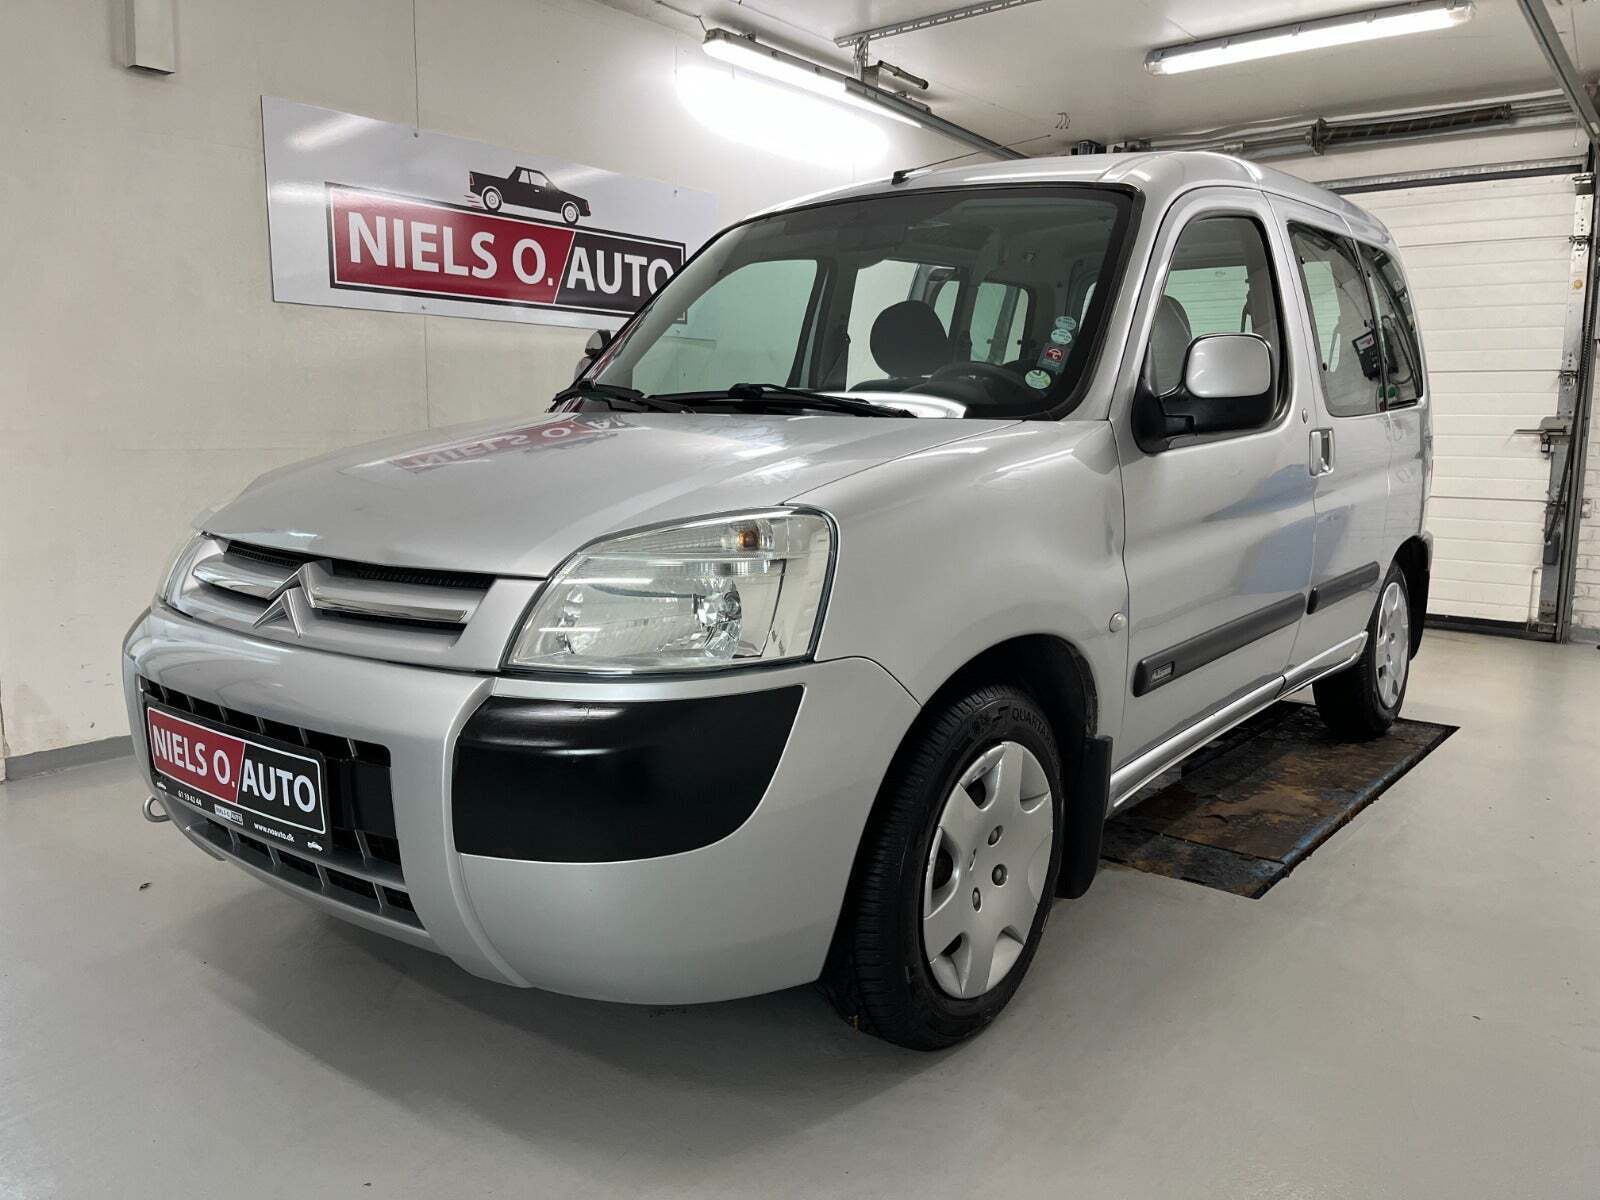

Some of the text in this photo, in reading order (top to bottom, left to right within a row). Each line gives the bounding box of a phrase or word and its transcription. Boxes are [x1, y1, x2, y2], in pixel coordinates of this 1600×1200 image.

[348, 211, 673, 297] NIELS O. AUTO
[152, 724, 316, 813] NIELS O. AUTO
